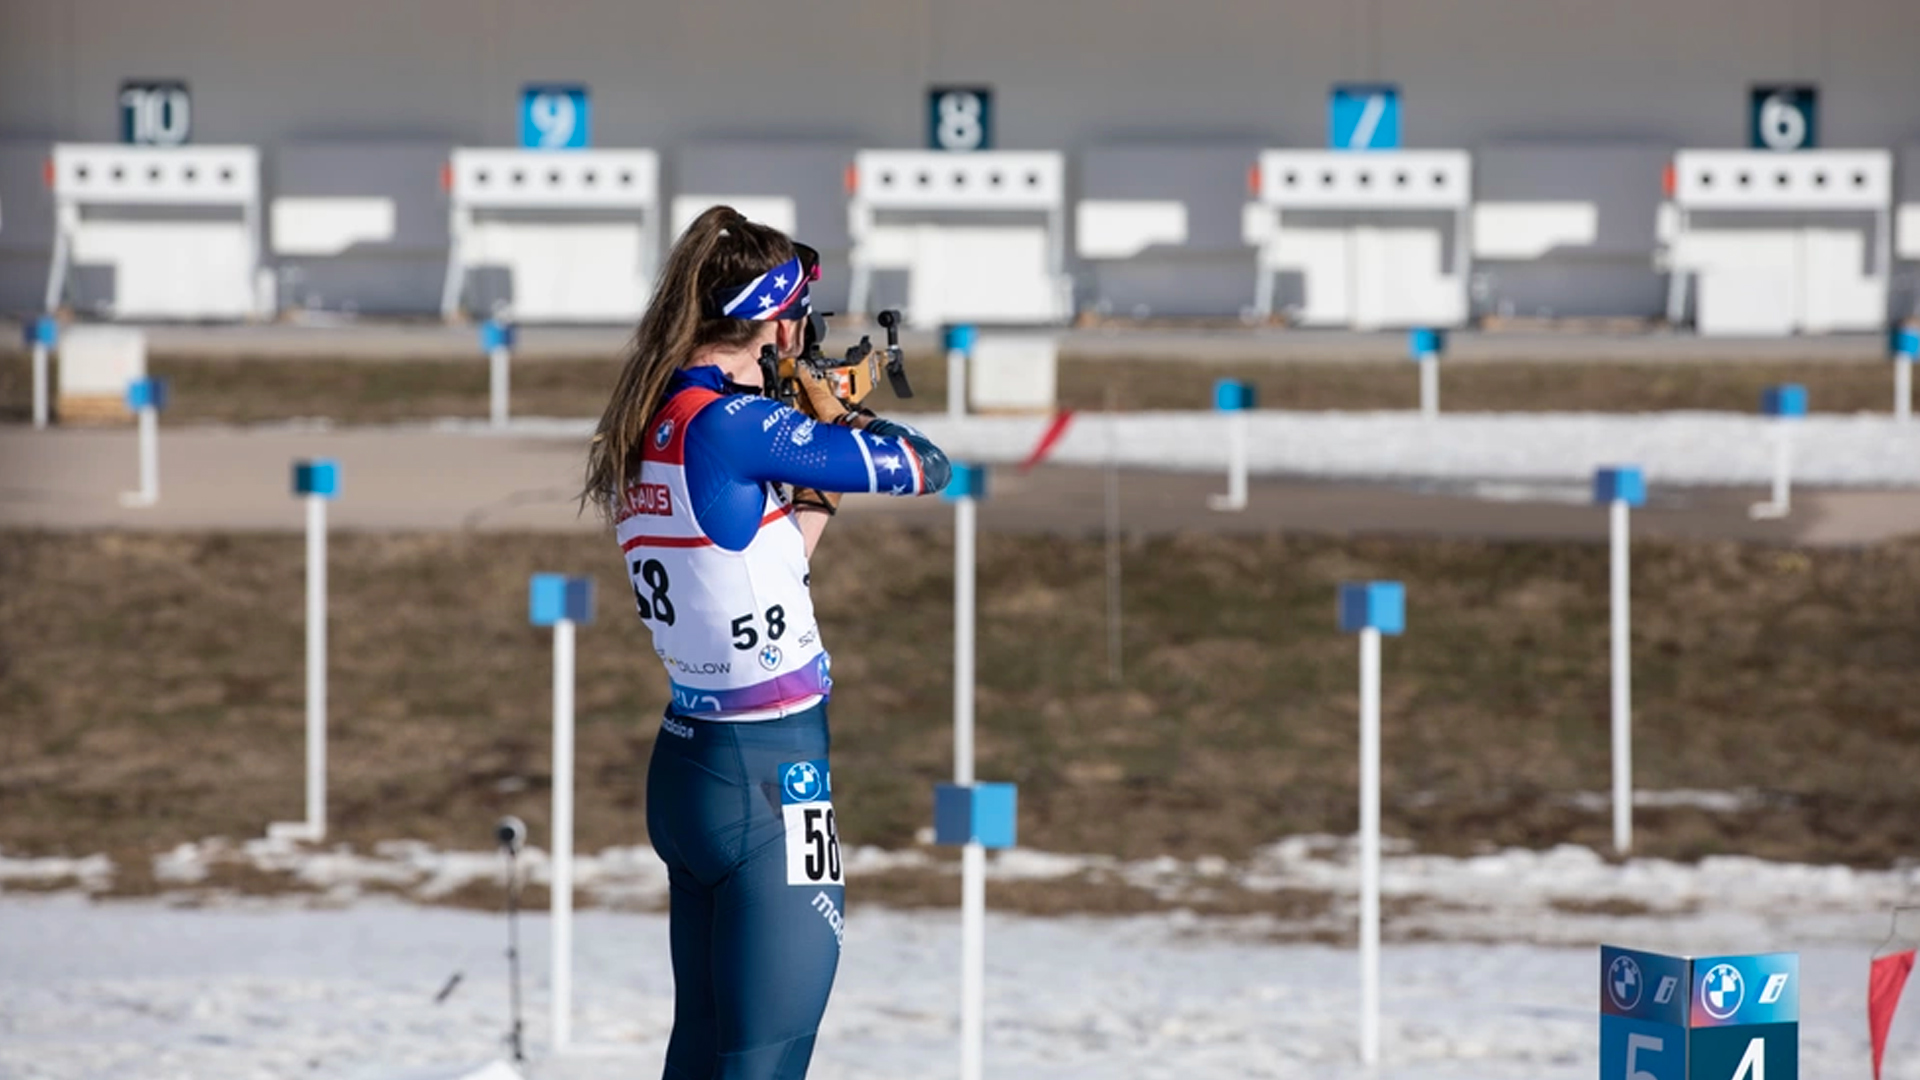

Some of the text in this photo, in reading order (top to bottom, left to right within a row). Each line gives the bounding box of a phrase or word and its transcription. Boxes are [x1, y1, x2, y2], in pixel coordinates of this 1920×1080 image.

[121, 88, 190, 145] 10
[530, 91, 577, 149] 9
[938, 92, 982, 150] 8
[1759, 91, 1806, 151] 6
[627, 488, 669, 511] HAUS
[731, 604, 786, 650] 58
[804, 809, 840, 881] 58
